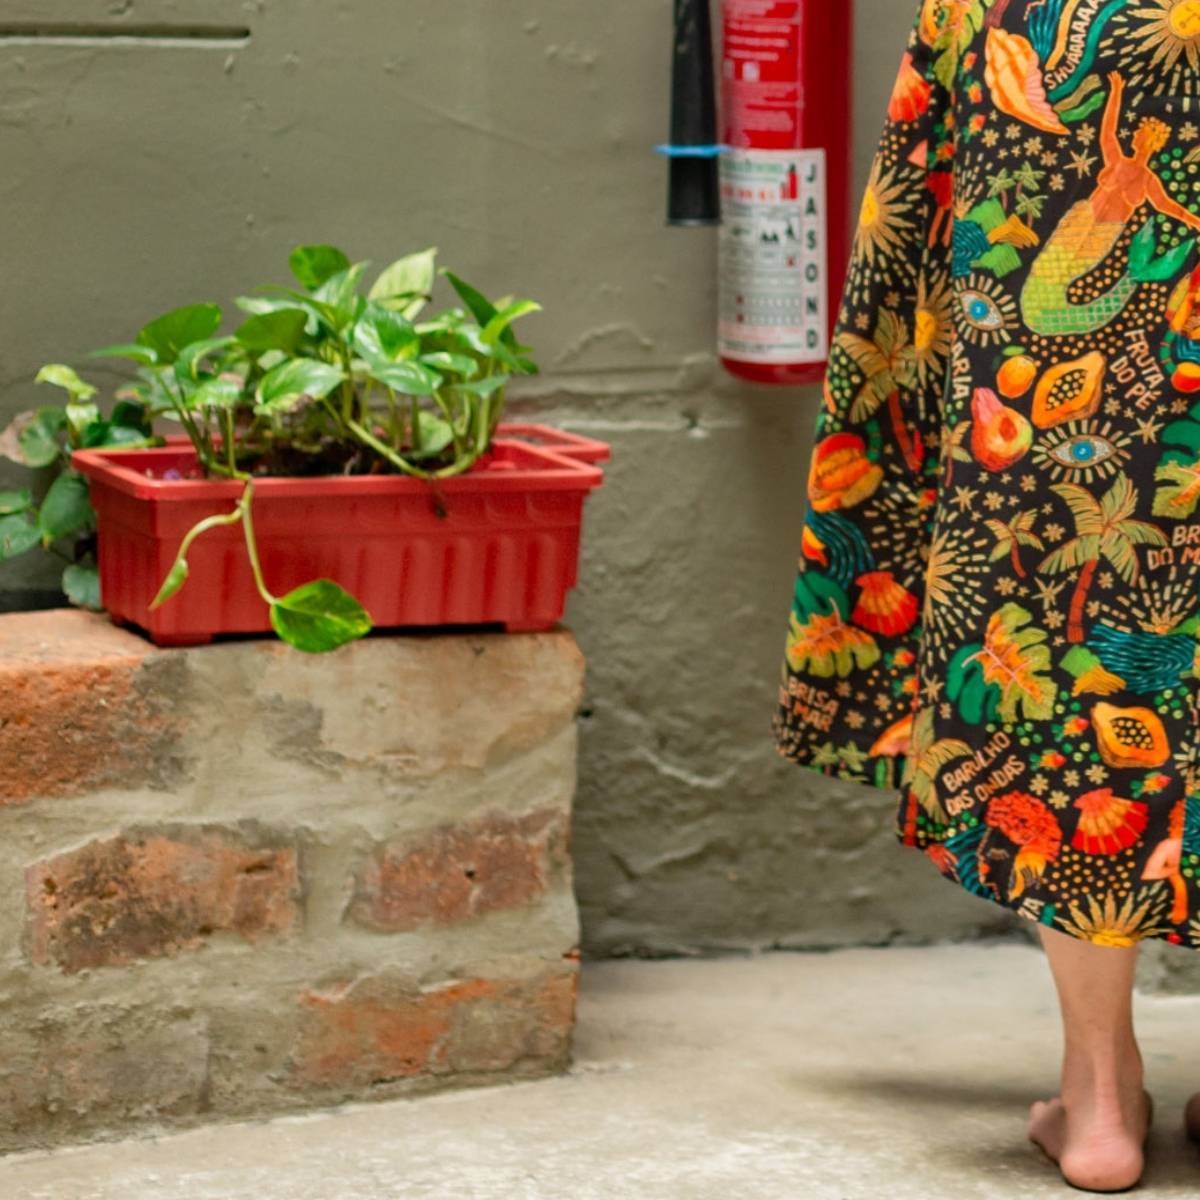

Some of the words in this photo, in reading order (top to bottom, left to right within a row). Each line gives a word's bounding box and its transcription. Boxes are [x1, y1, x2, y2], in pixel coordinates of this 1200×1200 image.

[1109, 355, 1136, 385] DO
[1123, 381, 1163, 411] PÉ
[1123, 328, 1165, 390] FRUTA
[942, 731, 1011, 792] BARULHO
[945, 789, 975, 816] DAS
[974, 755, 1026, 802] ONDAS
